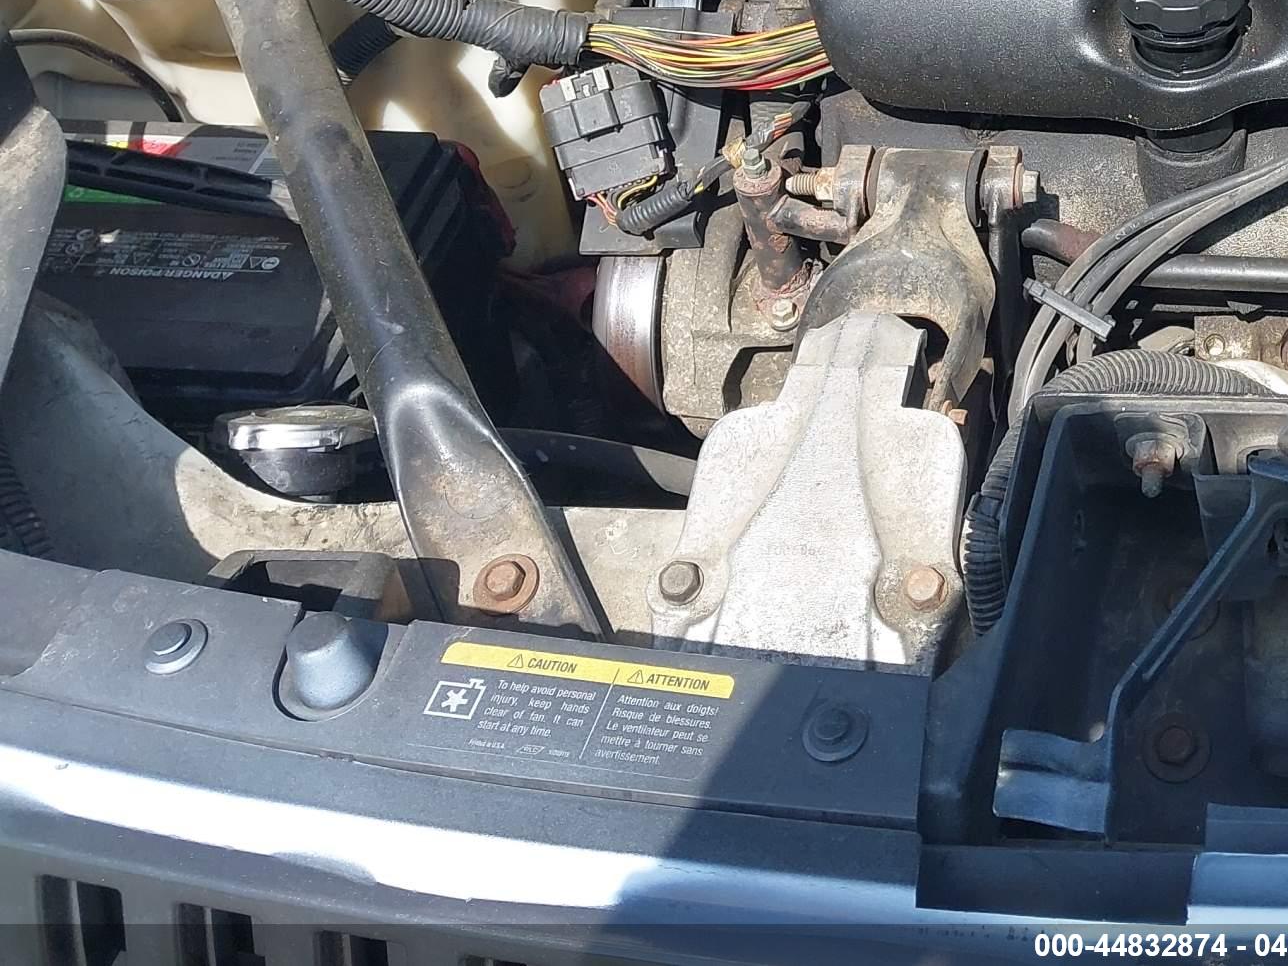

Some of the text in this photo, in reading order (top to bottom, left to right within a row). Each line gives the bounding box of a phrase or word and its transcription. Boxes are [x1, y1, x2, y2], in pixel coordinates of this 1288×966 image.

[527, 658, 578, 674] CAUTION
[498, 680, 597, 701] To help avoid personal
[646, 674, 710, 691] ATTENTION
[490, 694, 590, 714] injury, keep hands
[617, 694, 720, 716] Attention aux doigts!
[484, 706, 584, 728] clear of fan. It can
[612, 707, 712, 730] Risque de blessures.
[477, 719, 552, 738] start at any time.
[606, 721, 709, 743] Le ventilateur peut se
[594, 747, 661, 766] avertissement.
[600, 735, 704, 757] mettre à tourner sans
